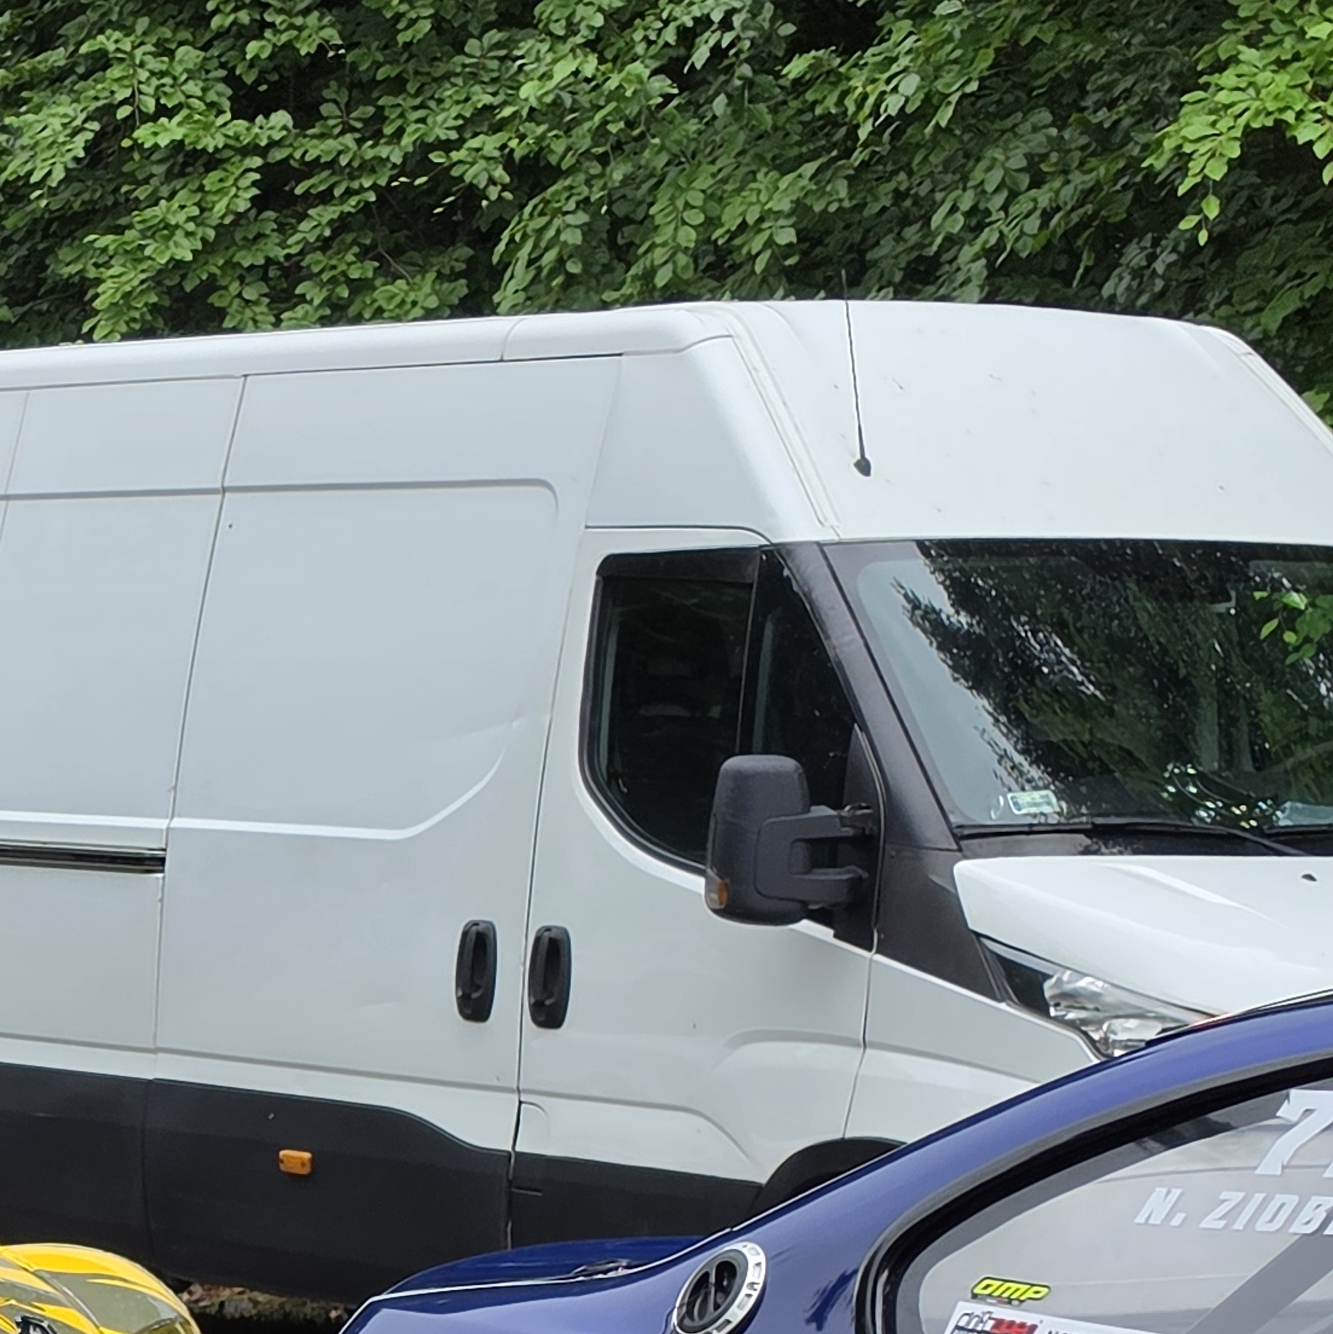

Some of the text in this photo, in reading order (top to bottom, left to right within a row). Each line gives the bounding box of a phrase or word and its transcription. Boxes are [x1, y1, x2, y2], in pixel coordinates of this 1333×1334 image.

[1254, 1088, 1333, 1179] 7
[1134, 1187, 1333, 1236] N. ZIOB
